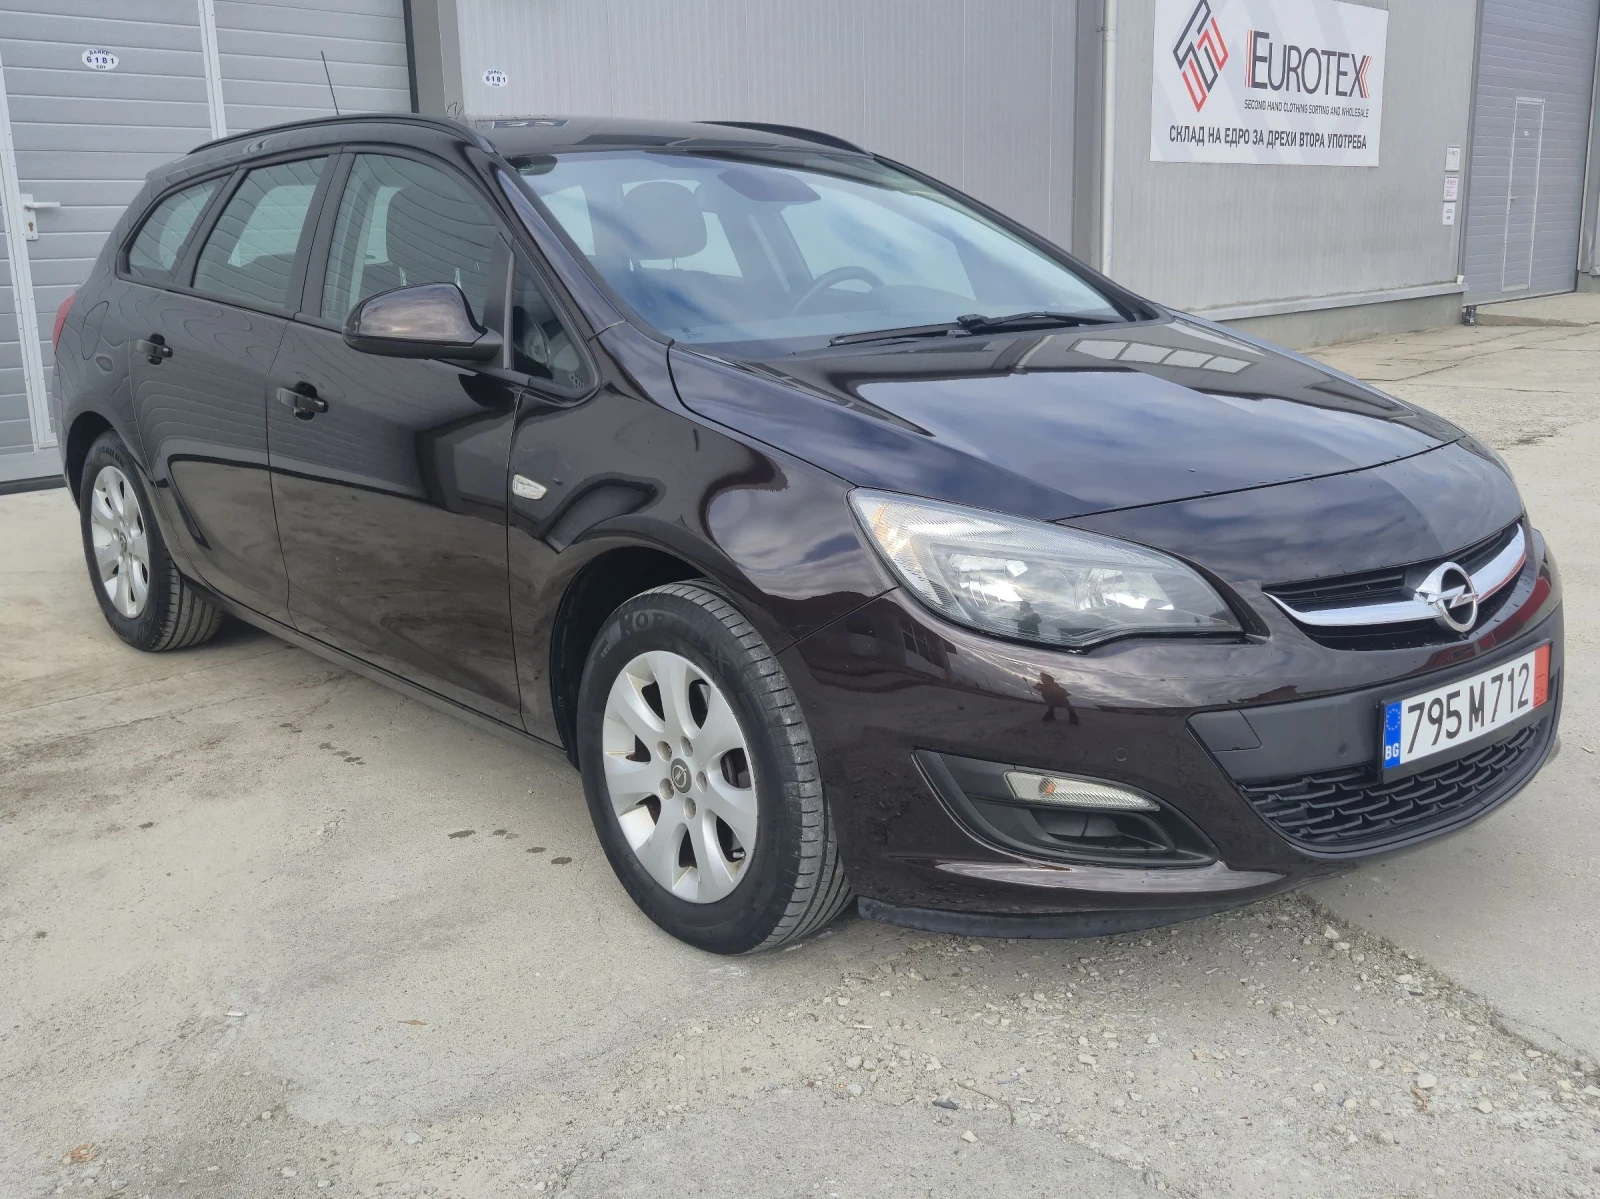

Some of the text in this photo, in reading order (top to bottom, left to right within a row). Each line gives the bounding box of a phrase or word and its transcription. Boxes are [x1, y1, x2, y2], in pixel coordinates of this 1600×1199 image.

[1244, 99, 1369, 118] SECOND HAND CLOTHING SORTING AND WHOLESALE
[1169, 125, 1367, 149] СКЛАД НА ЕДРО ЗА ДРЕХИ ВТОРА УПОТРЕБА
[1385, 743, 1399, 760] BG
